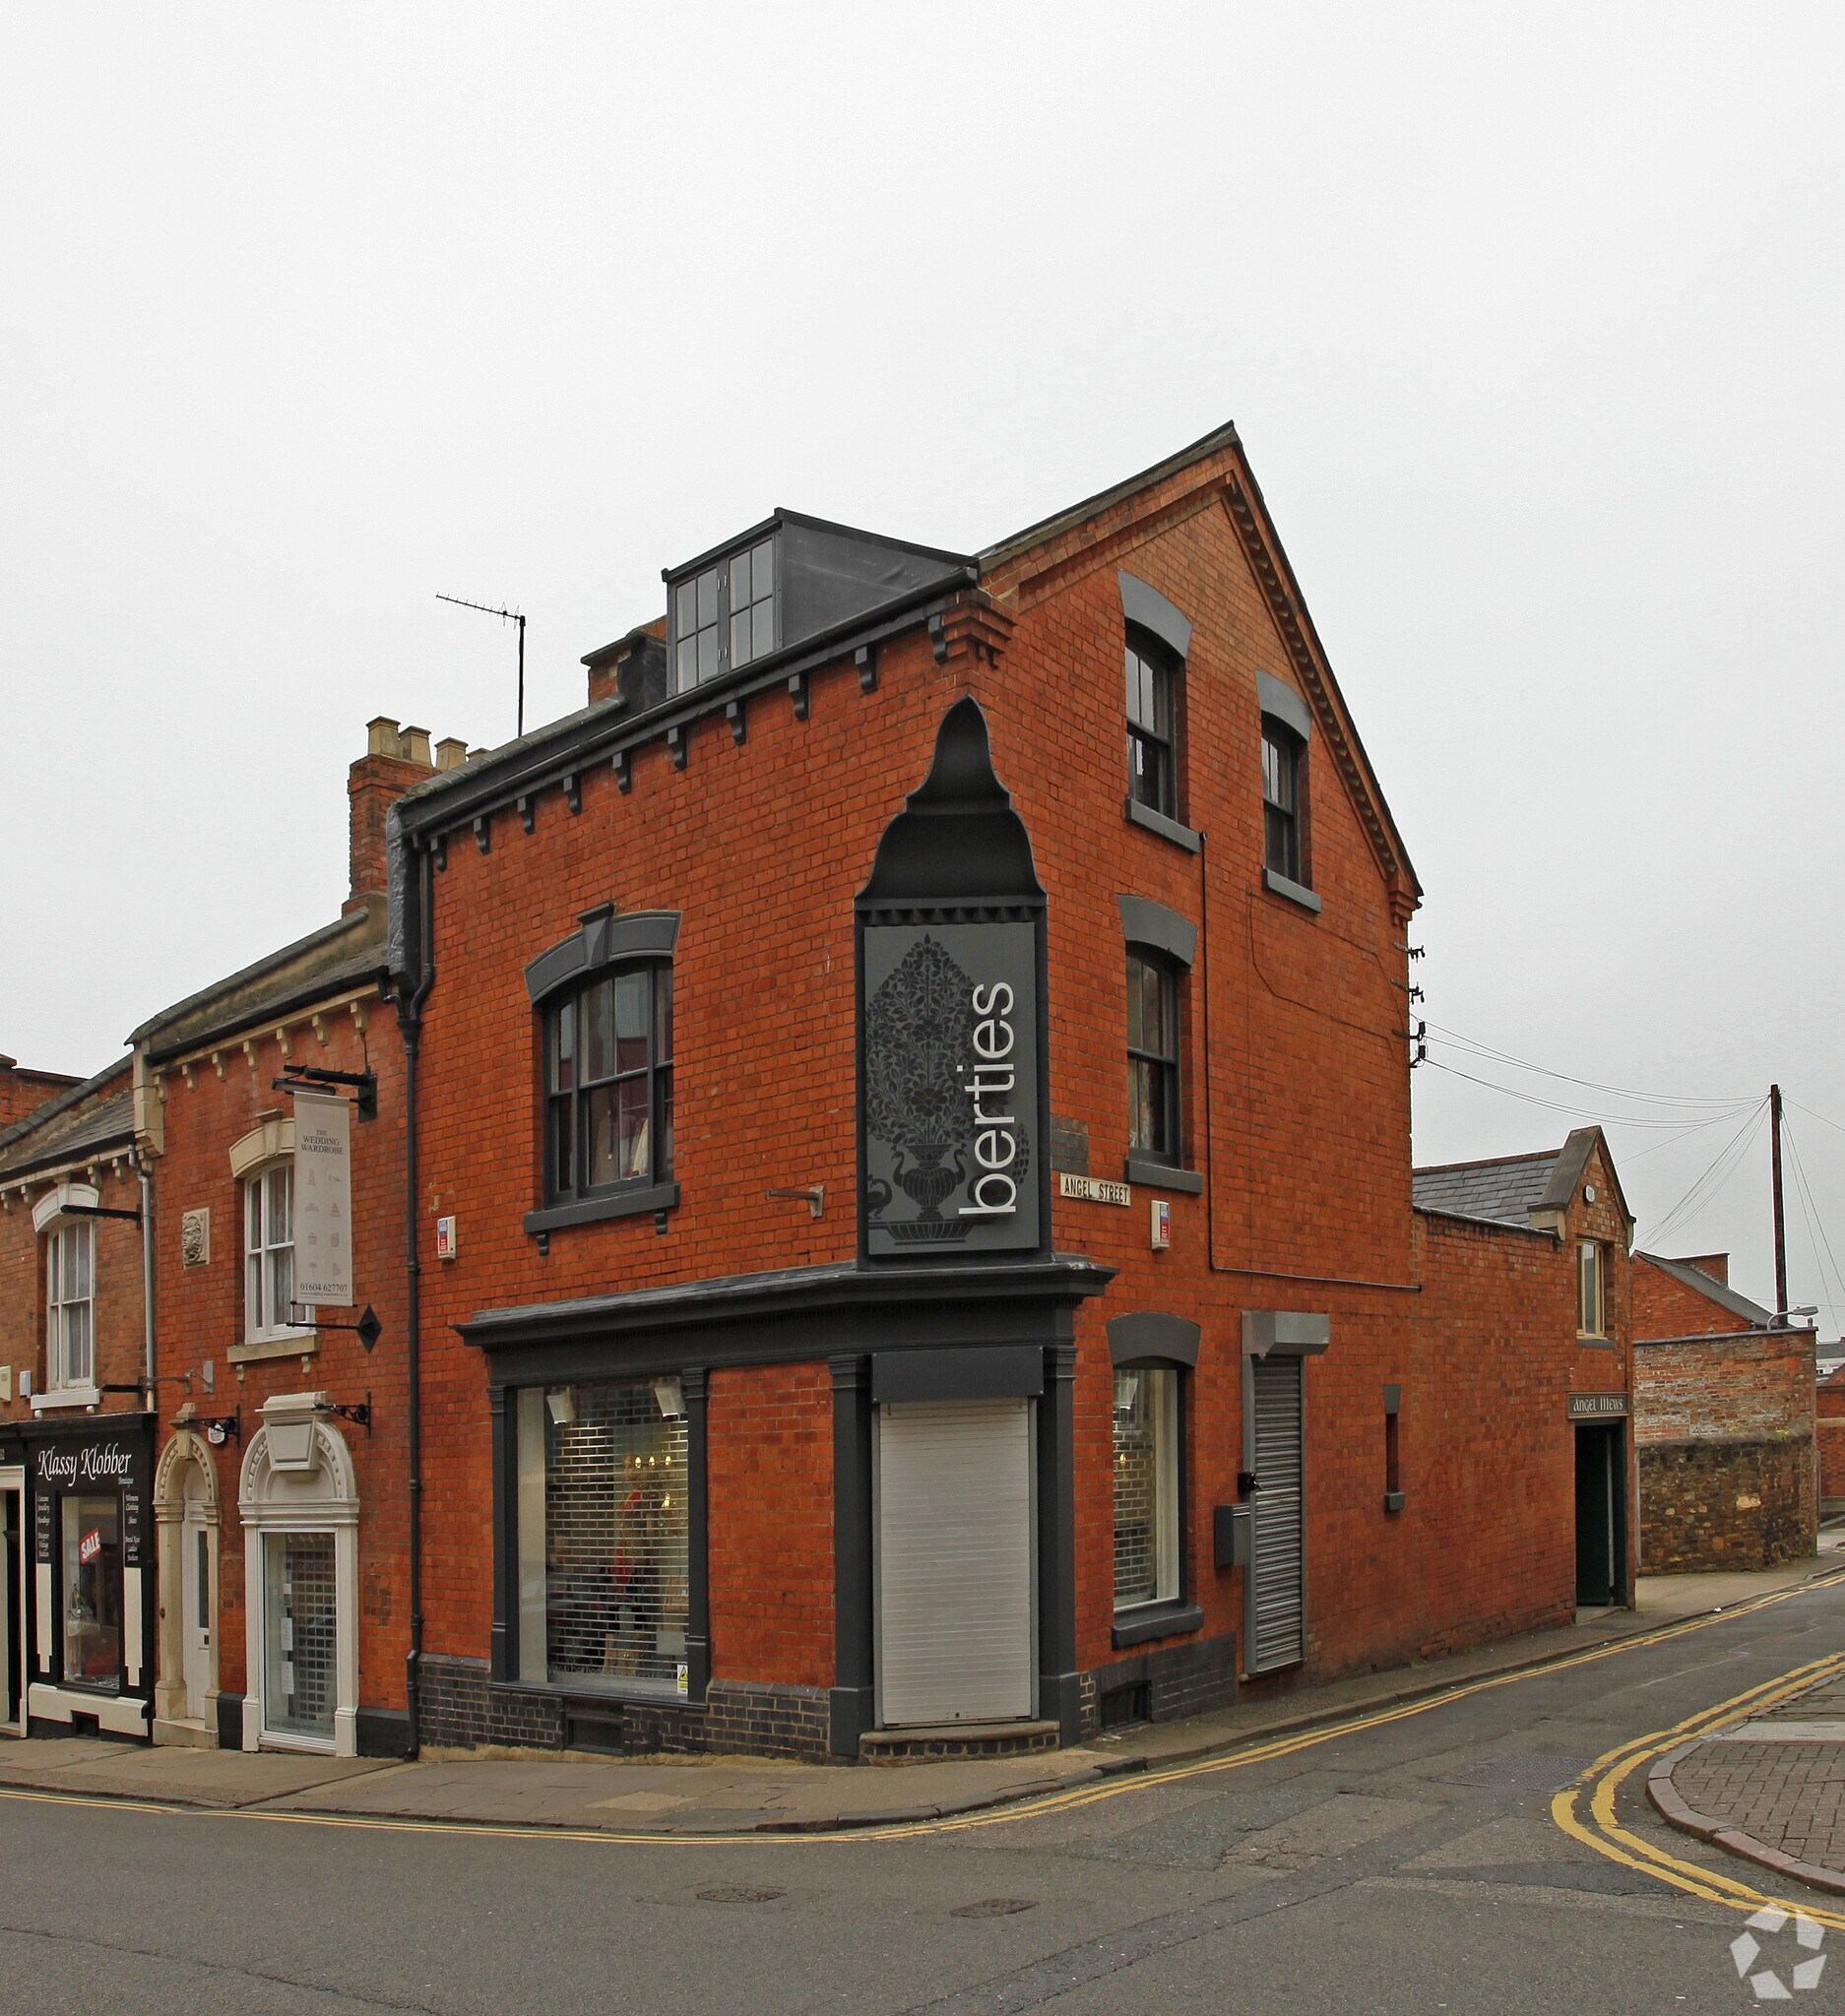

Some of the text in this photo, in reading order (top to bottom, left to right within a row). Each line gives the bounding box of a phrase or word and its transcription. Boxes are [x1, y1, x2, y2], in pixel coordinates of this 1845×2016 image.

[956, 981, 1017, 1216] berties
[300, 1143, 345, 1155] WARDROBE
[302, 1135, 340, 1147] WEDDING
[1064, 1177, 1128, 1203] ANGEL STREET
[37, 1442, 132, 1487] Klassy Klobber
[81, 1532, 101, 1559] SALE
